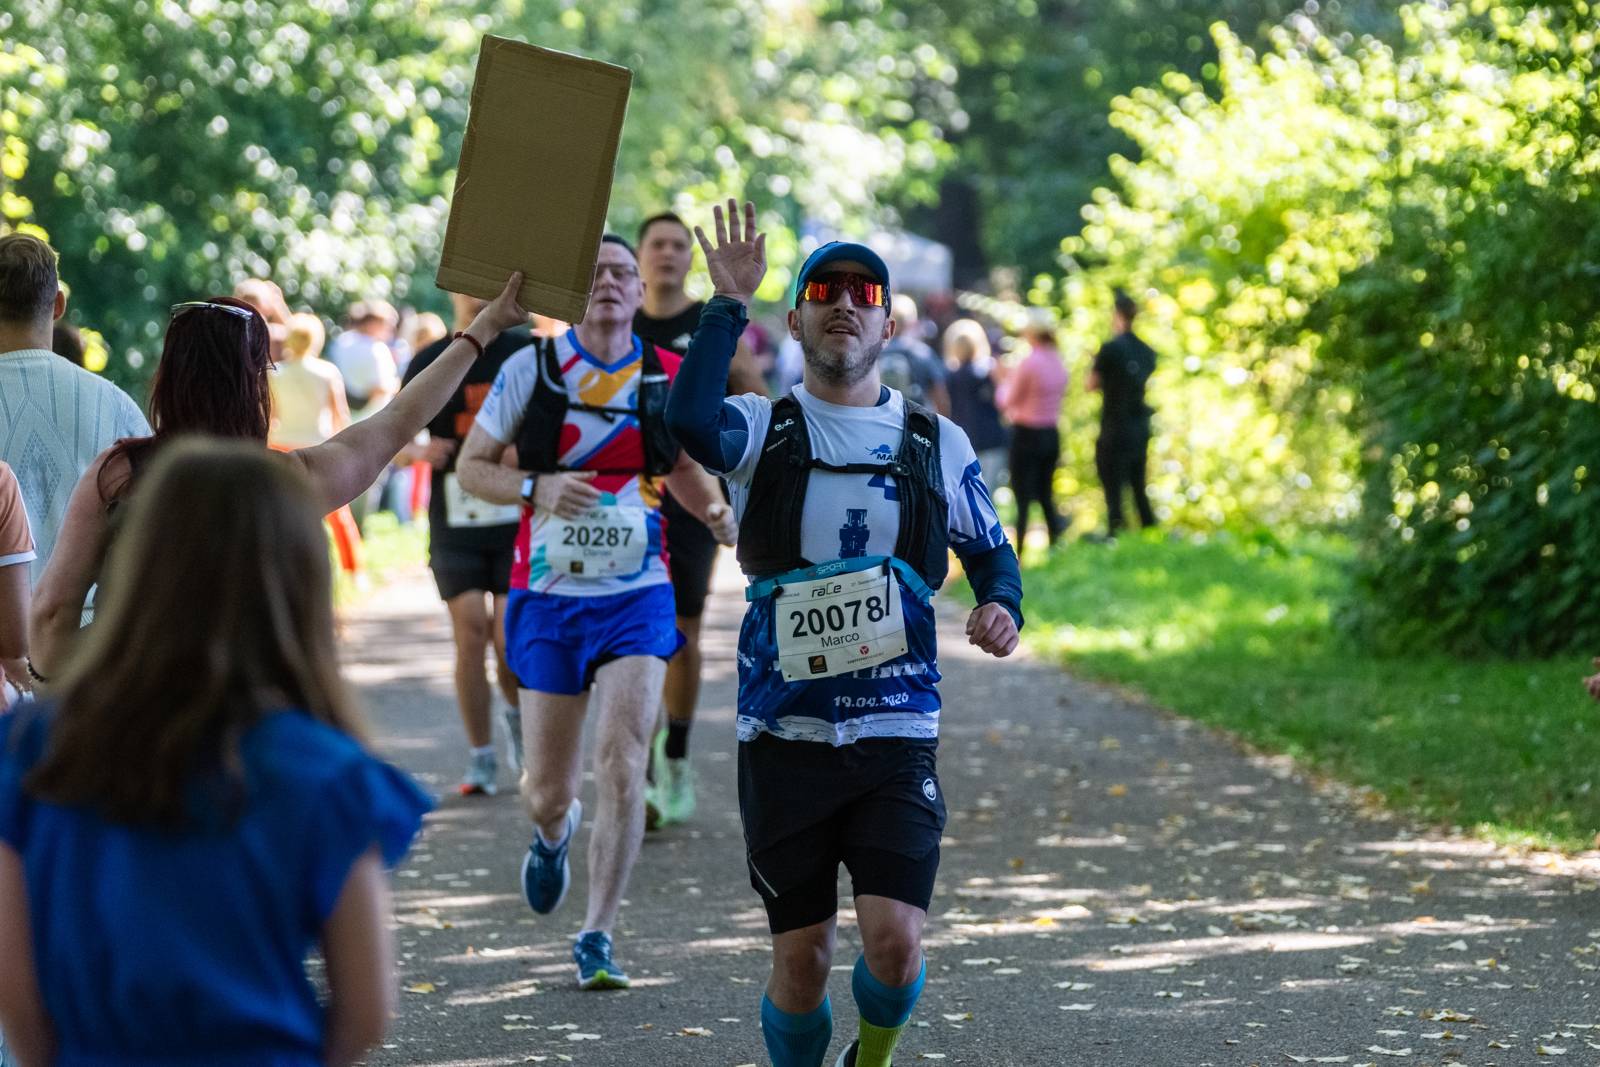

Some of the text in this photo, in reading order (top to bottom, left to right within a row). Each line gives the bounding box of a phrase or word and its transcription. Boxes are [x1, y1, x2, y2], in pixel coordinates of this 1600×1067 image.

[912, 432, 932, 448] evoc
[562, 525, 634, 547] 20287
[816, 561, 848, 576] SPORT
[790, 595, 885, 638] 20078
[821, 631, 860, 648] Marco
